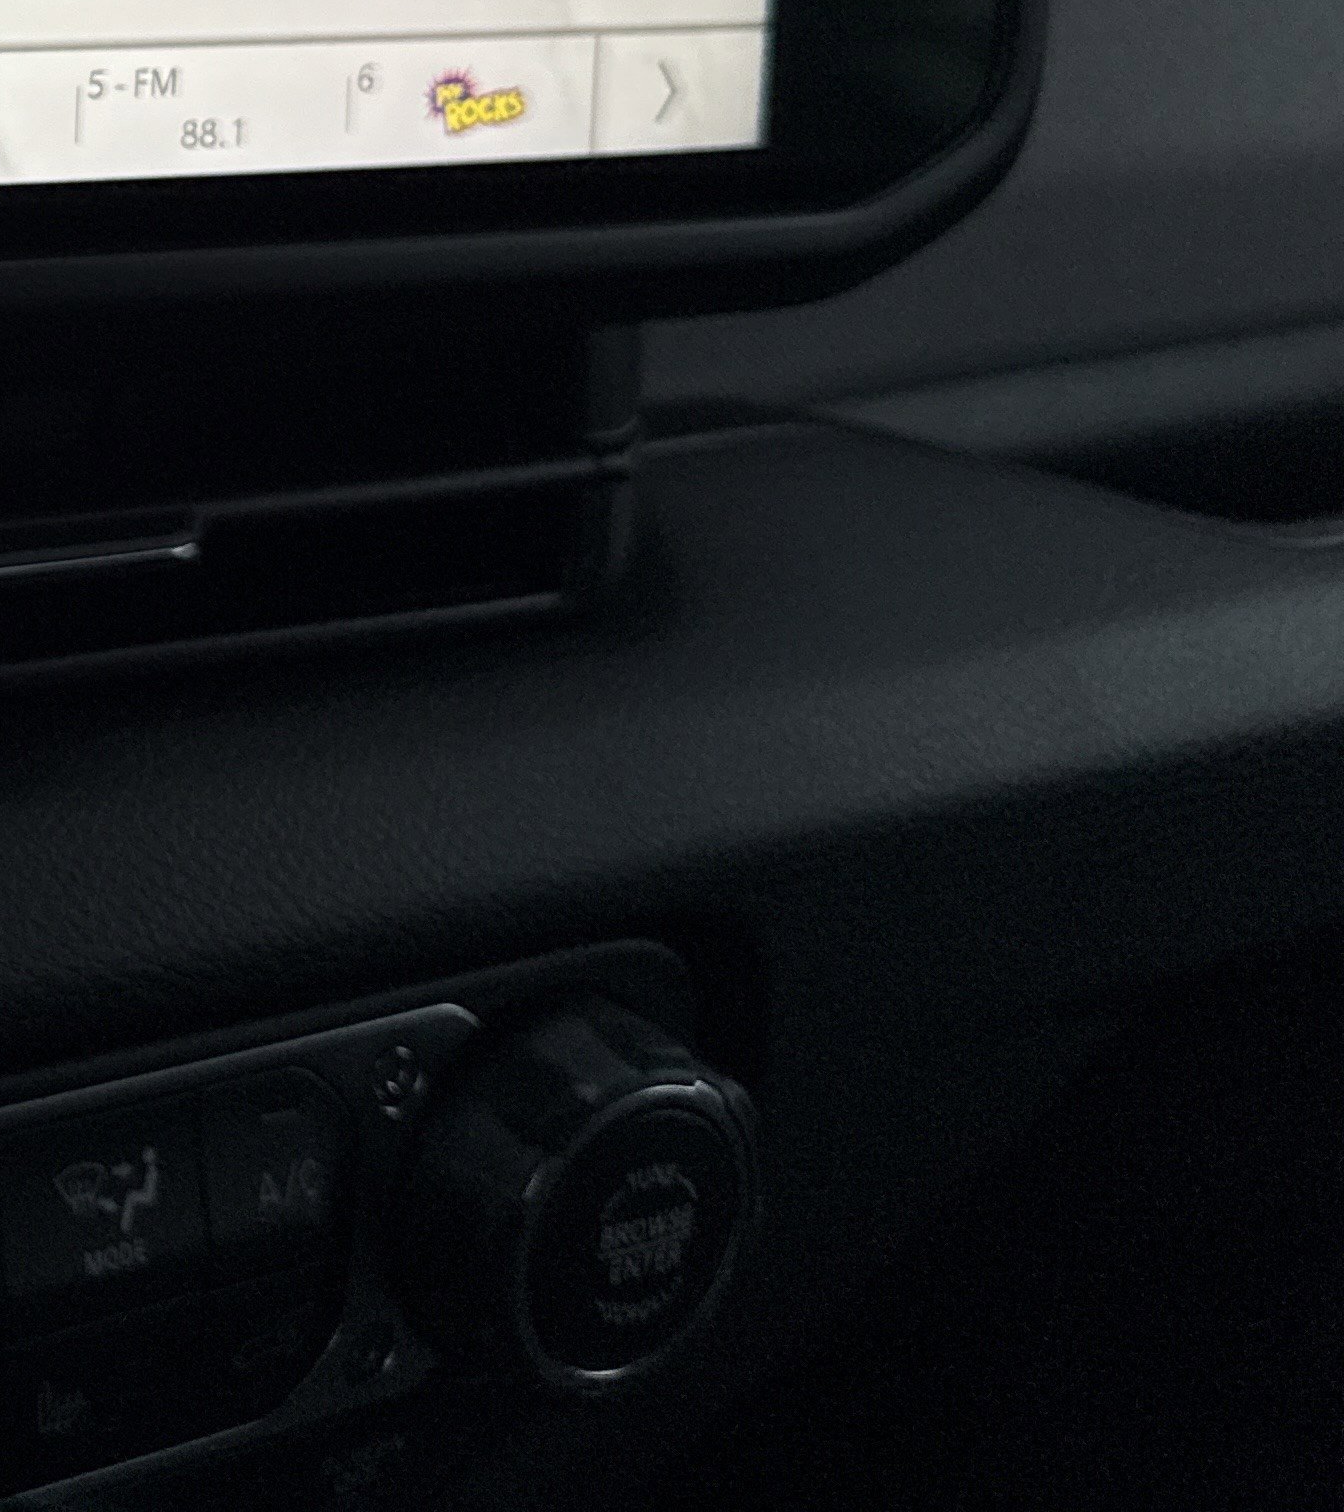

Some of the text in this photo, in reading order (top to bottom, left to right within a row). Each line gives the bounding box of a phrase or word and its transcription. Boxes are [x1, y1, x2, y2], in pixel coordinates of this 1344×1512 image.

[87, 67, 106, 101] 5
[133, 66, 179, 99] FM
[355, 62, 375, 93] 6
[179, 117, 245, 151] 88.1
[84, 1238, 149, 1277] MODE
